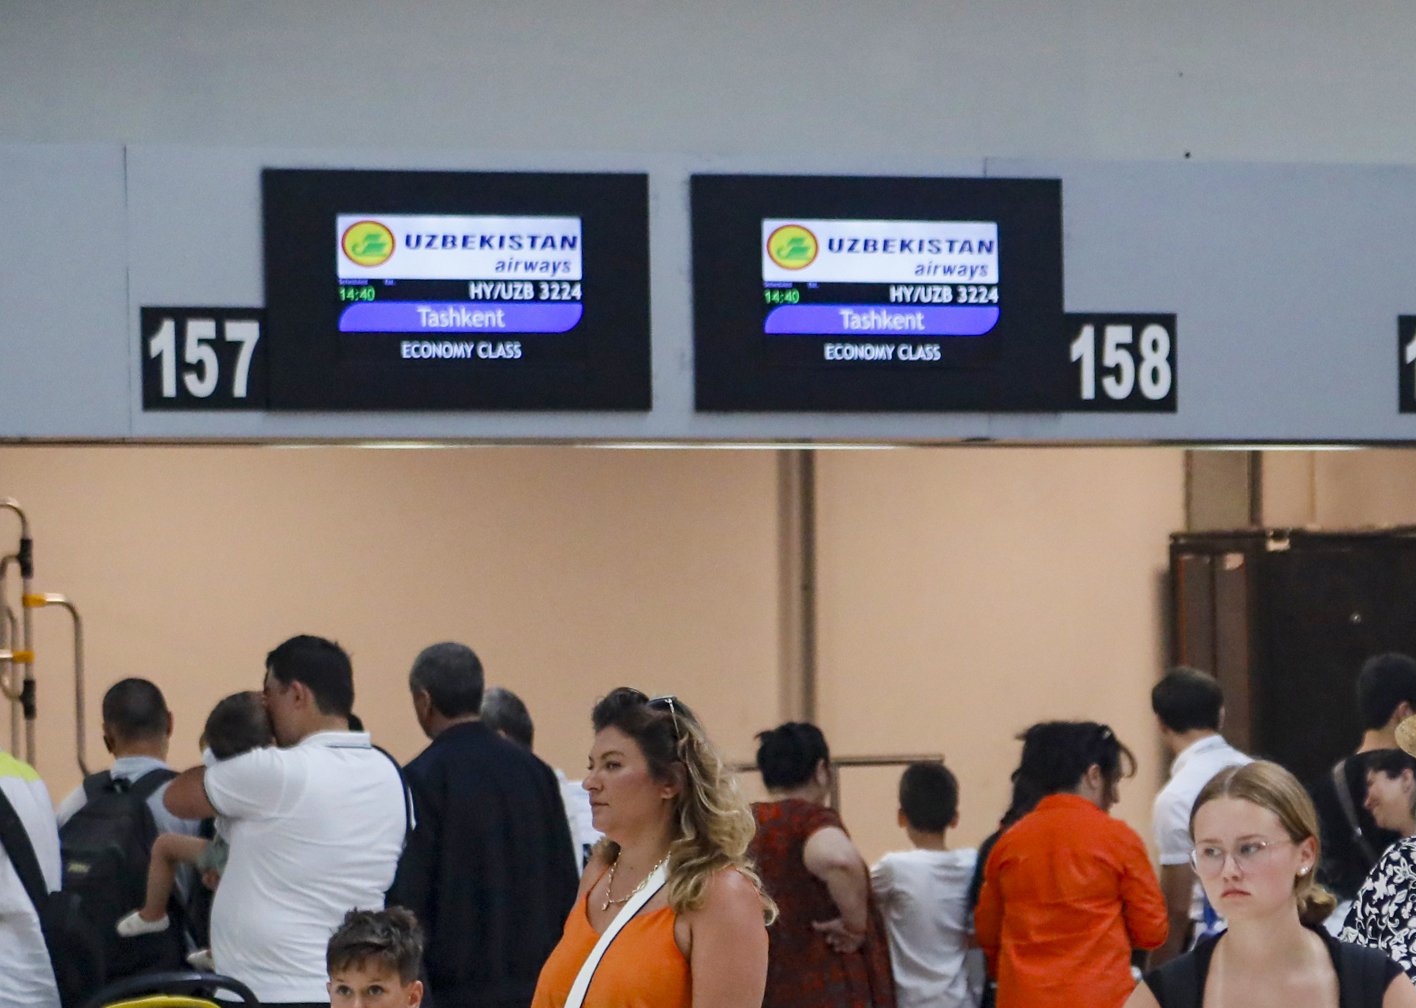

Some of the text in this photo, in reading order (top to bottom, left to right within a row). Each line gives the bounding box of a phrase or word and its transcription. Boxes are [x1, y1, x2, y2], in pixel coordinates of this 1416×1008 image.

[405, 233, 578, 250] UZBEKISTAN
[827, 238, 994, 254] UZBEKISTAN
[495, 257, 571, 277] airways
[914, 260, 988, 280] airways
[339, 285, 375, 301] 14:40
[469, 282, 582, 300] HY/UZB 3224
[764, 288, 800, 304] 14:40
[889, 285, 999, 303] HY/UZB 3224
[417, 306, 505, 328] Tashkent
[839, 308, 925, 331] Tashkent
[148, 317, 260, 399] 157
[401, 341, 522, 359] ECONOMY CLASS
[823, 343, 941, 361] ECONOMY CLASS
[1069, 323, 1172, 401] 158
